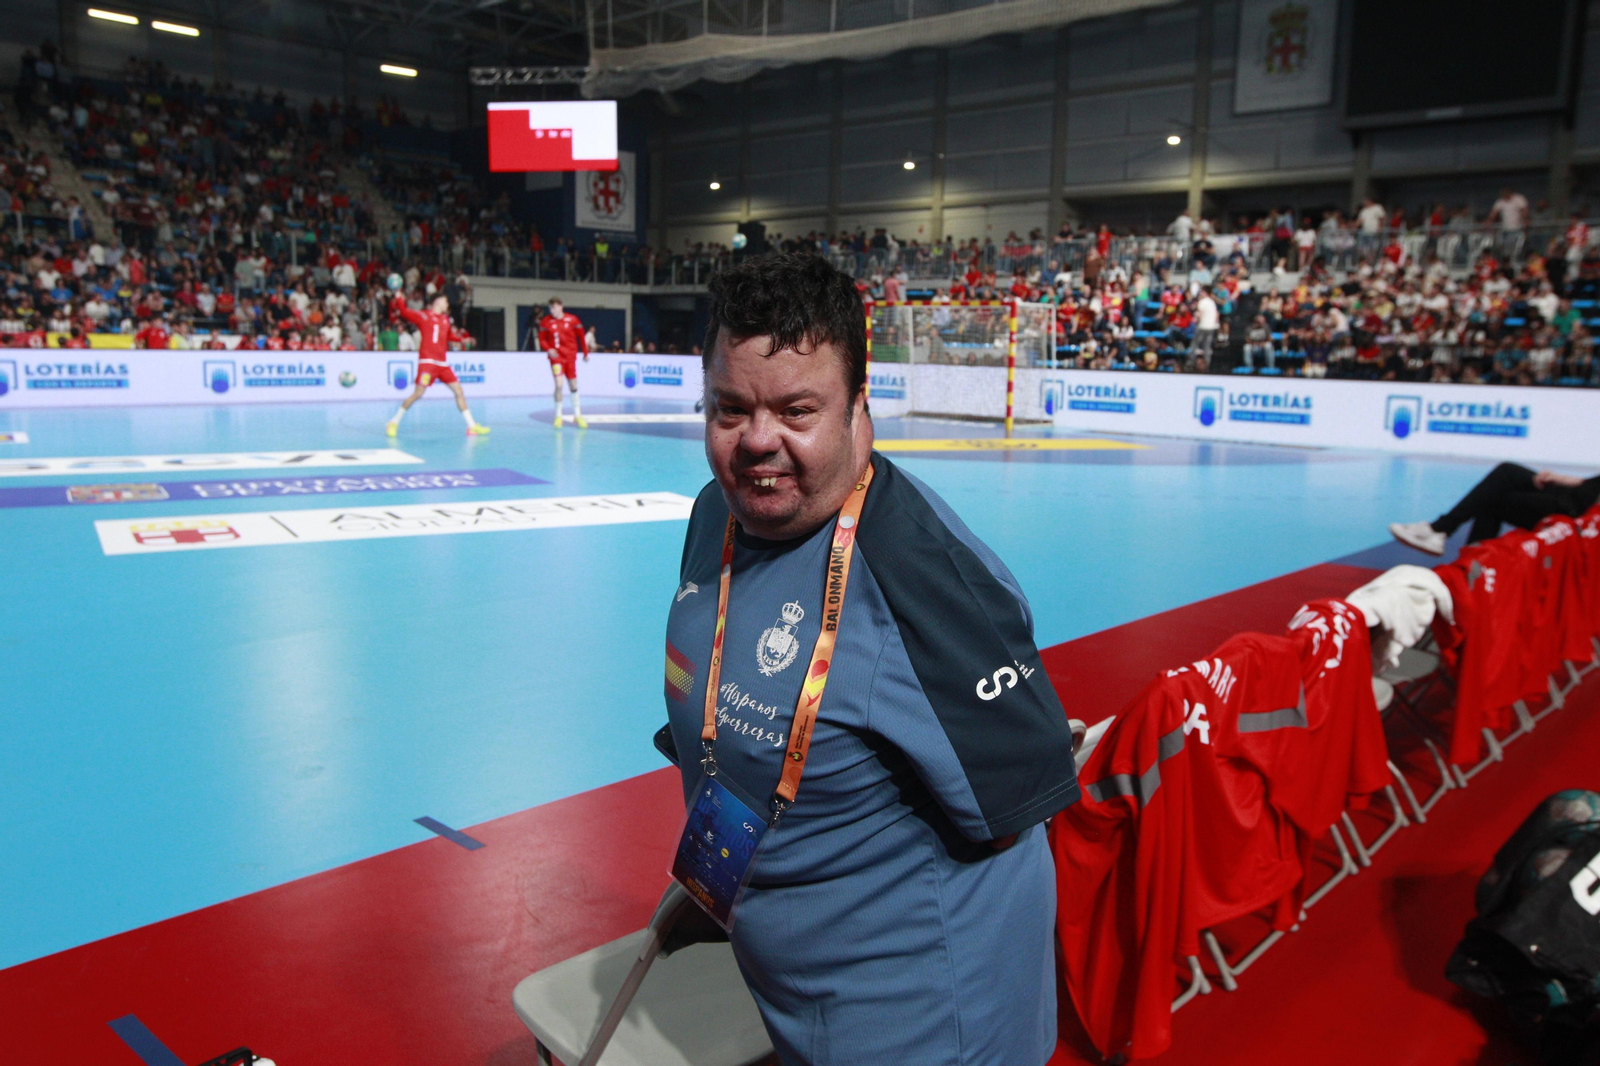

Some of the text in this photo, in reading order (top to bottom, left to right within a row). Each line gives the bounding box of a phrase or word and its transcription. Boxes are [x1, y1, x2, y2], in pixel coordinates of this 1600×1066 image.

[24, 362, 129, 376] LOTERÍAS
[242, 361, 326, 375] LOTERÍAS
[450, 361, 486, 373] RÍAS
[641, 364, 684, 376] LOTERÍAS
[871, 373, 907, 387] ERÍAS
[1068, 383, 1137, 399] LOTERÍAS
[1229, 392, 1312, 409] LOTERÍAS
[1427, 401, 1531, 419] LOTERÍAS
[329, 496, 684, 524] ALMERÍA
[336, 515, 537, 532] CIUDAD
[826, 546, 845, 632] BALONMANO
[719, 682, 781, 721] #Hispanos
